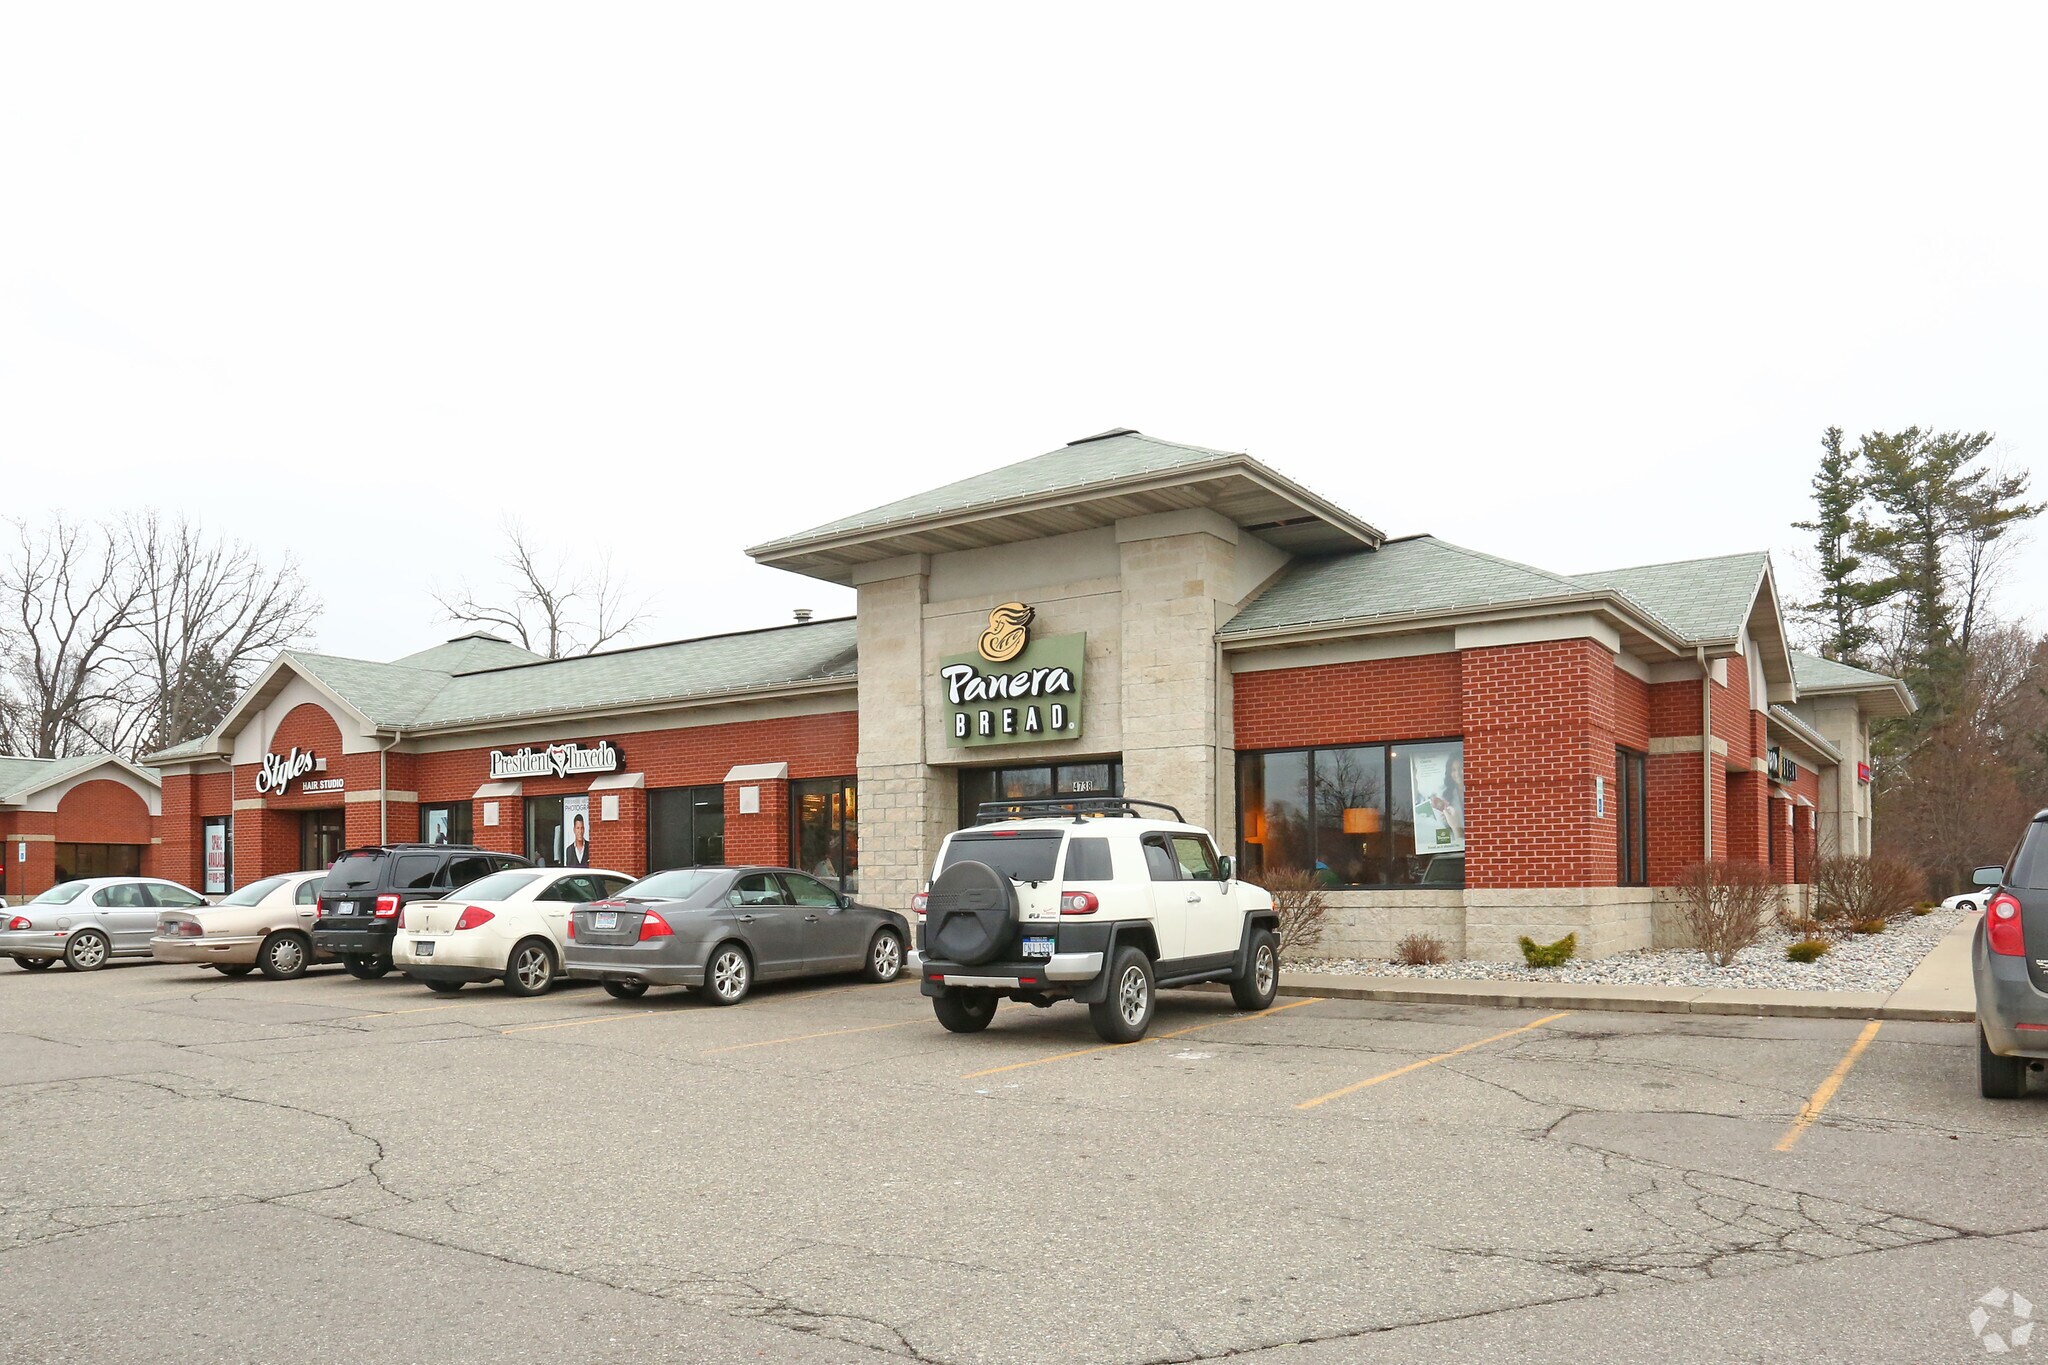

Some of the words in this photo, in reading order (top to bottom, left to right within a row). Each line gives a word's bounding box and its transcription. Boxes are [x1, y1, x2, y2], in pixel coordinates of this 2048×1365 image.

[941, 664, 1071, 704] Panera
[955, 703, 1064, 738] BREAD
[255, 746, 314, 796] Styles
[491, 749, 551, 776] President
[566, 741, 616, 770] Tuxedo
[302, 781, 318, 791] HAIR
[320, 779, 344, 789] STUDIO
[1072, 780, 1093, 792] 4738
